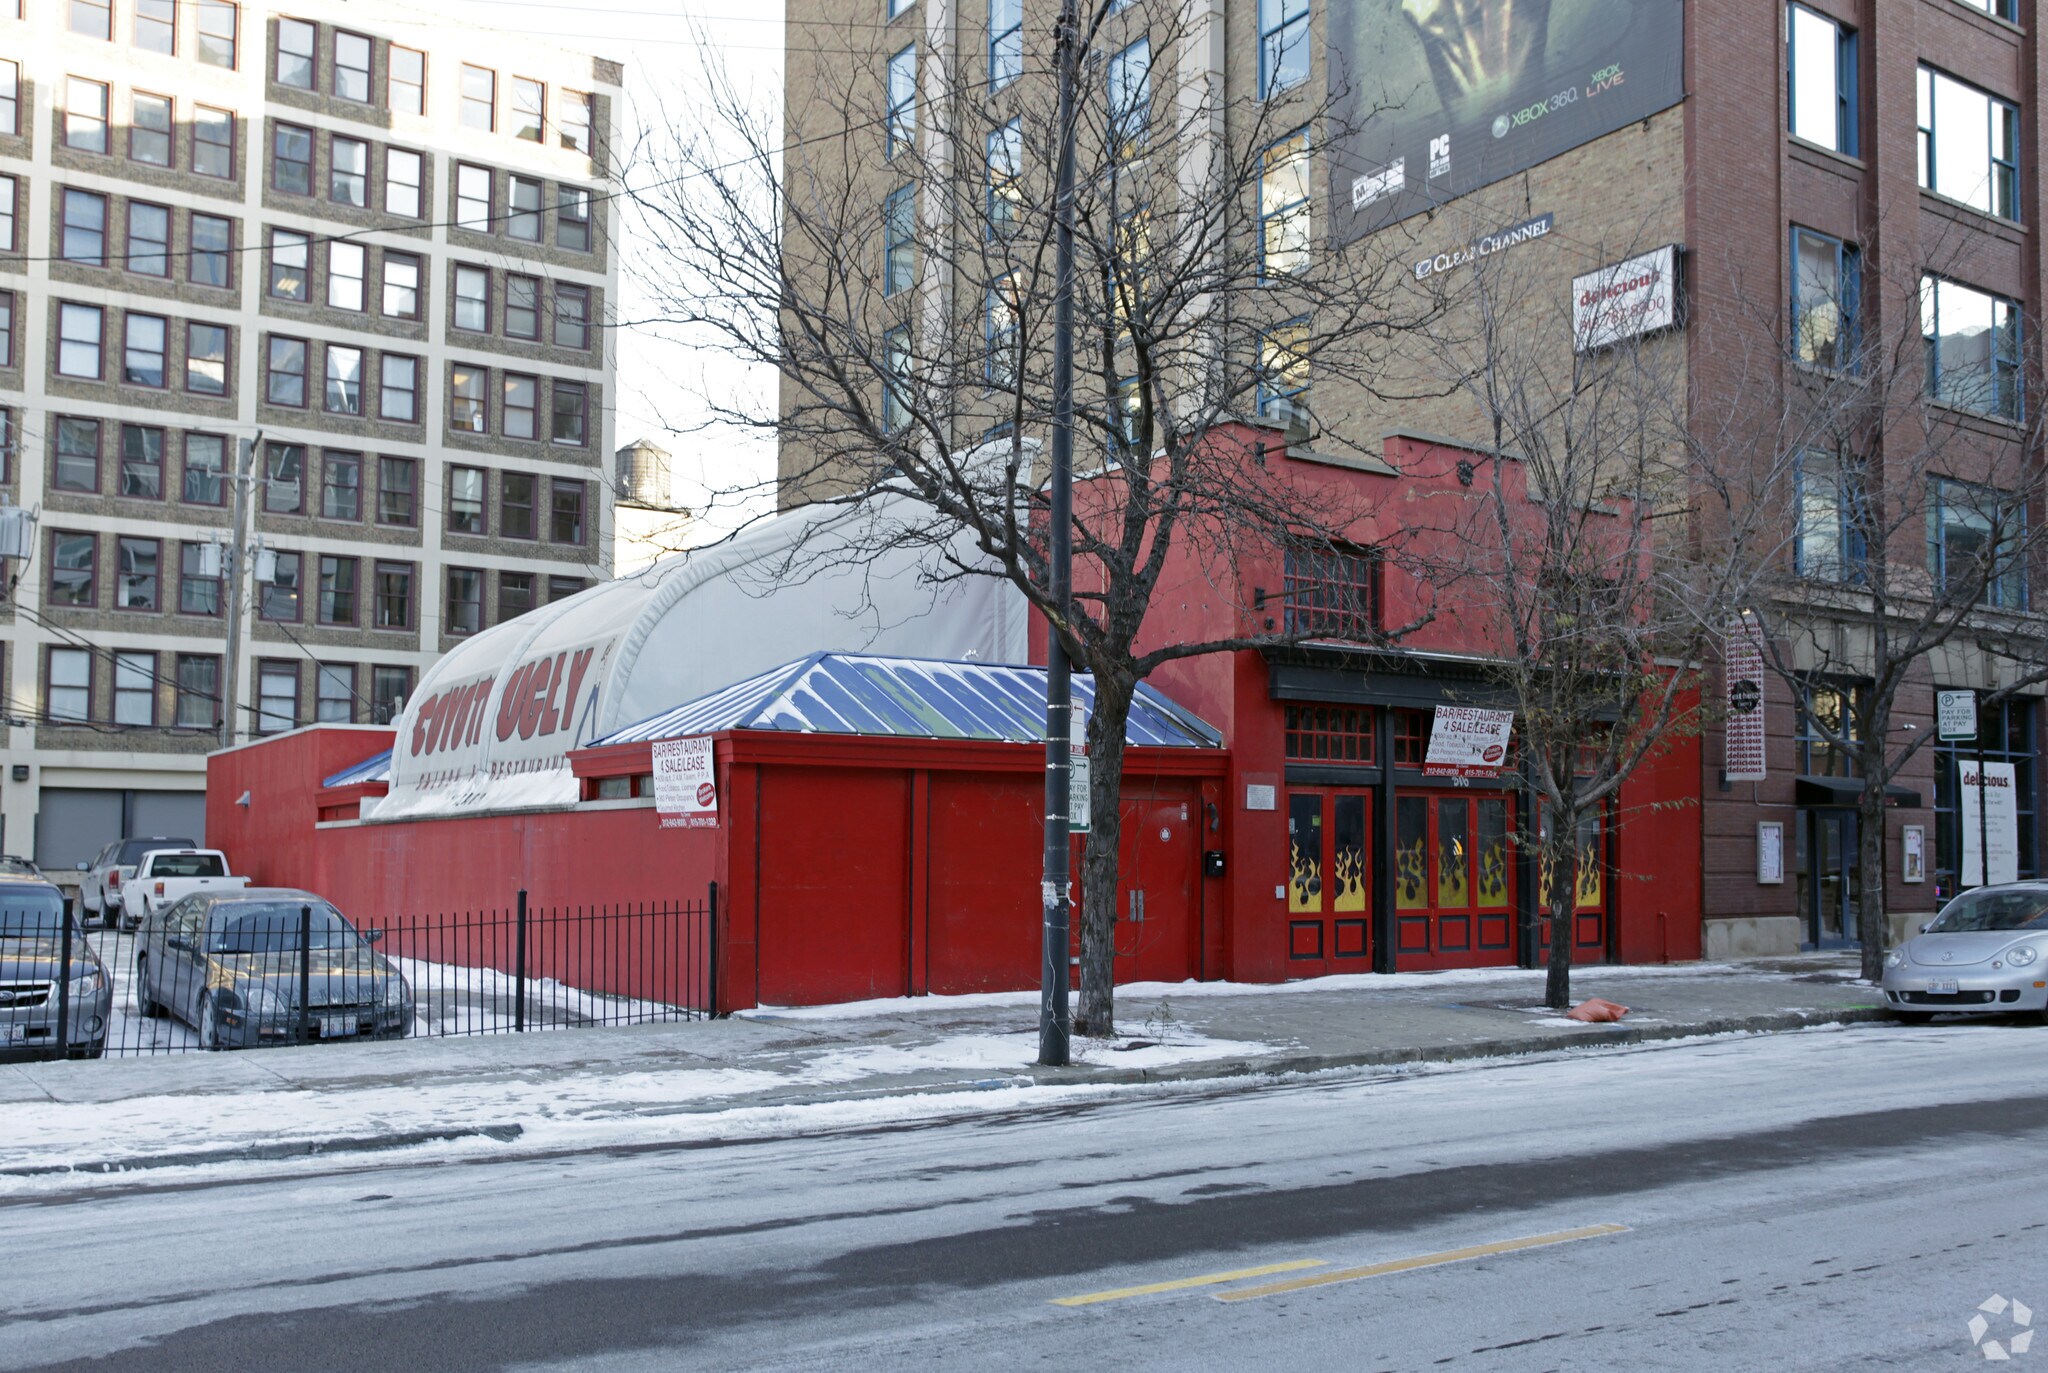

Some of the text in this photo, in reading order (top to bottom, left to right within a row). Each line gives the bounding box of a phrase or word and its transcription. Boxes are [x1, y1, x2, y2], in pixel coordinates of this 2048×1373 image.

[1591, 62, 1620, 84] XBOX
[1586, 72, 1625, 98] LIVE
[1511, 86, 1576, 128] XBOX 360
[1430, 133, 1450, 162] PC
[1479, 219, 1550, 256] CHANNEL
[496, 647, 594, 742] UGLY
[1435, 707, 1513, 724] BAR/RESTAURANT
[1443, 721, 1502, 735] 4 SALE/LEASE
[653, 738, 711, 759] BAR/RESTAURANT
[665, 756, 705, 774] SALE/LEASE
[1077, 784, 1087, 792] FOR
[1964, 771, 2008, 788] delcious
[1069, 793, 1088, 801] ARKING
